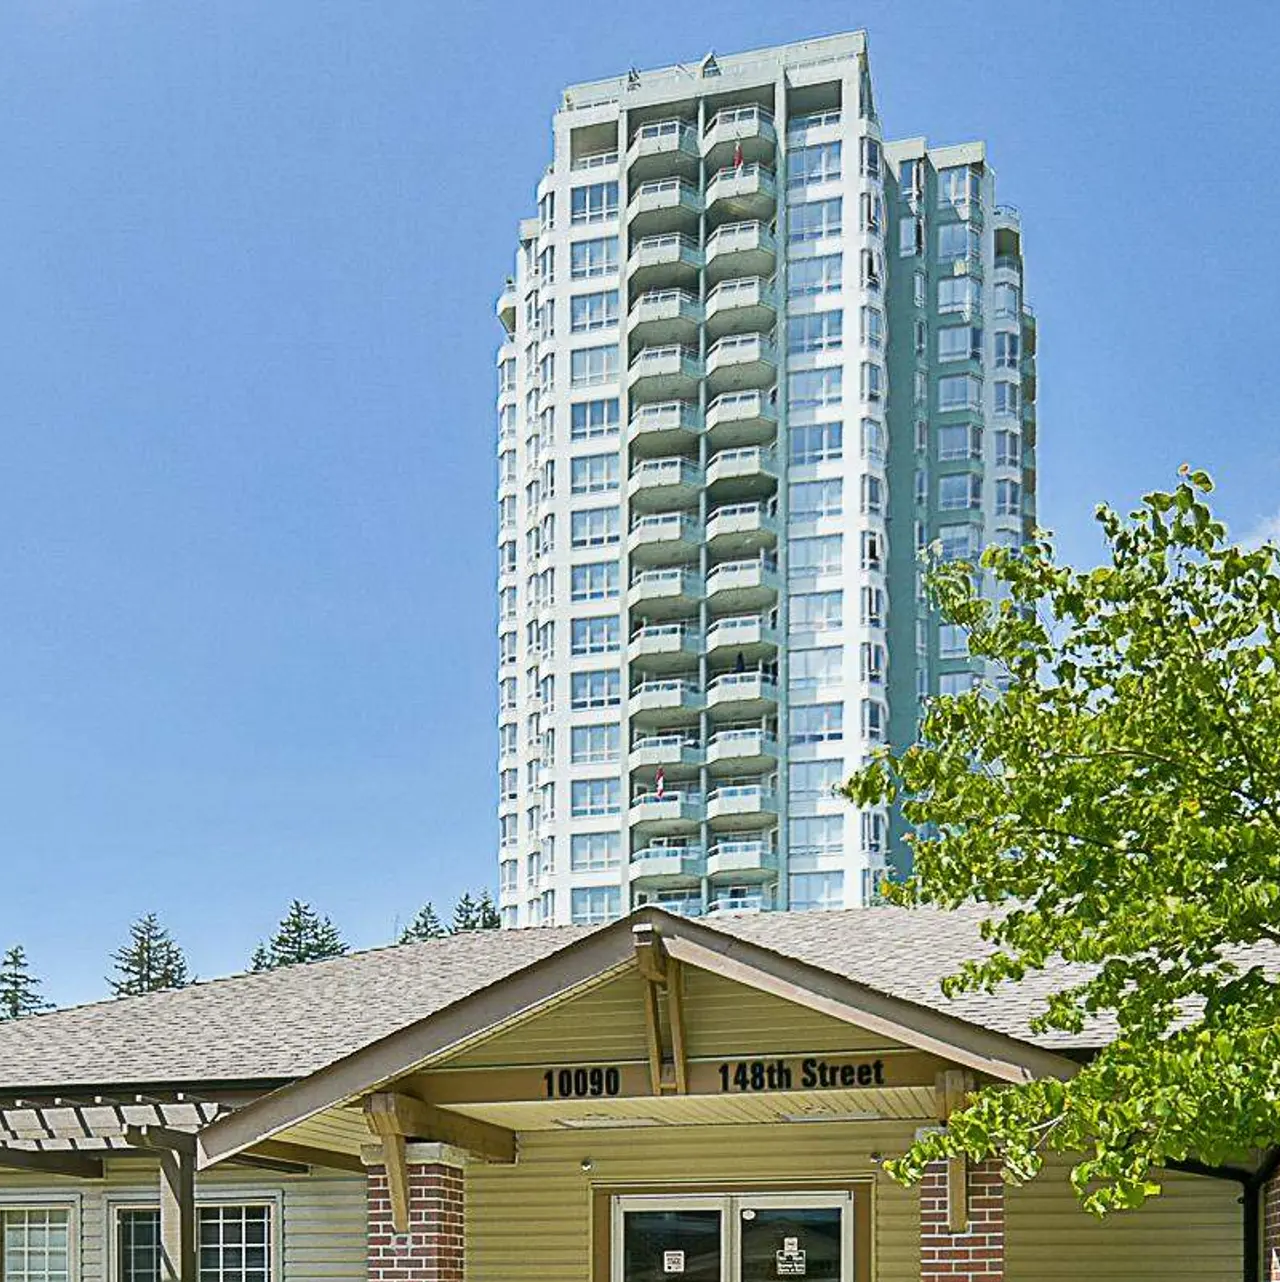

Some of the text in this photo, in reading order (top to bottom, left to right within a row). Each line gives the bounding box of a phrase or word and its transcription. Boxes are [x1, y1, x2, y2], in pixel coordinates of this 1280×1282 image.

[544, 1058, 885, 1097] 10090 148th Street
